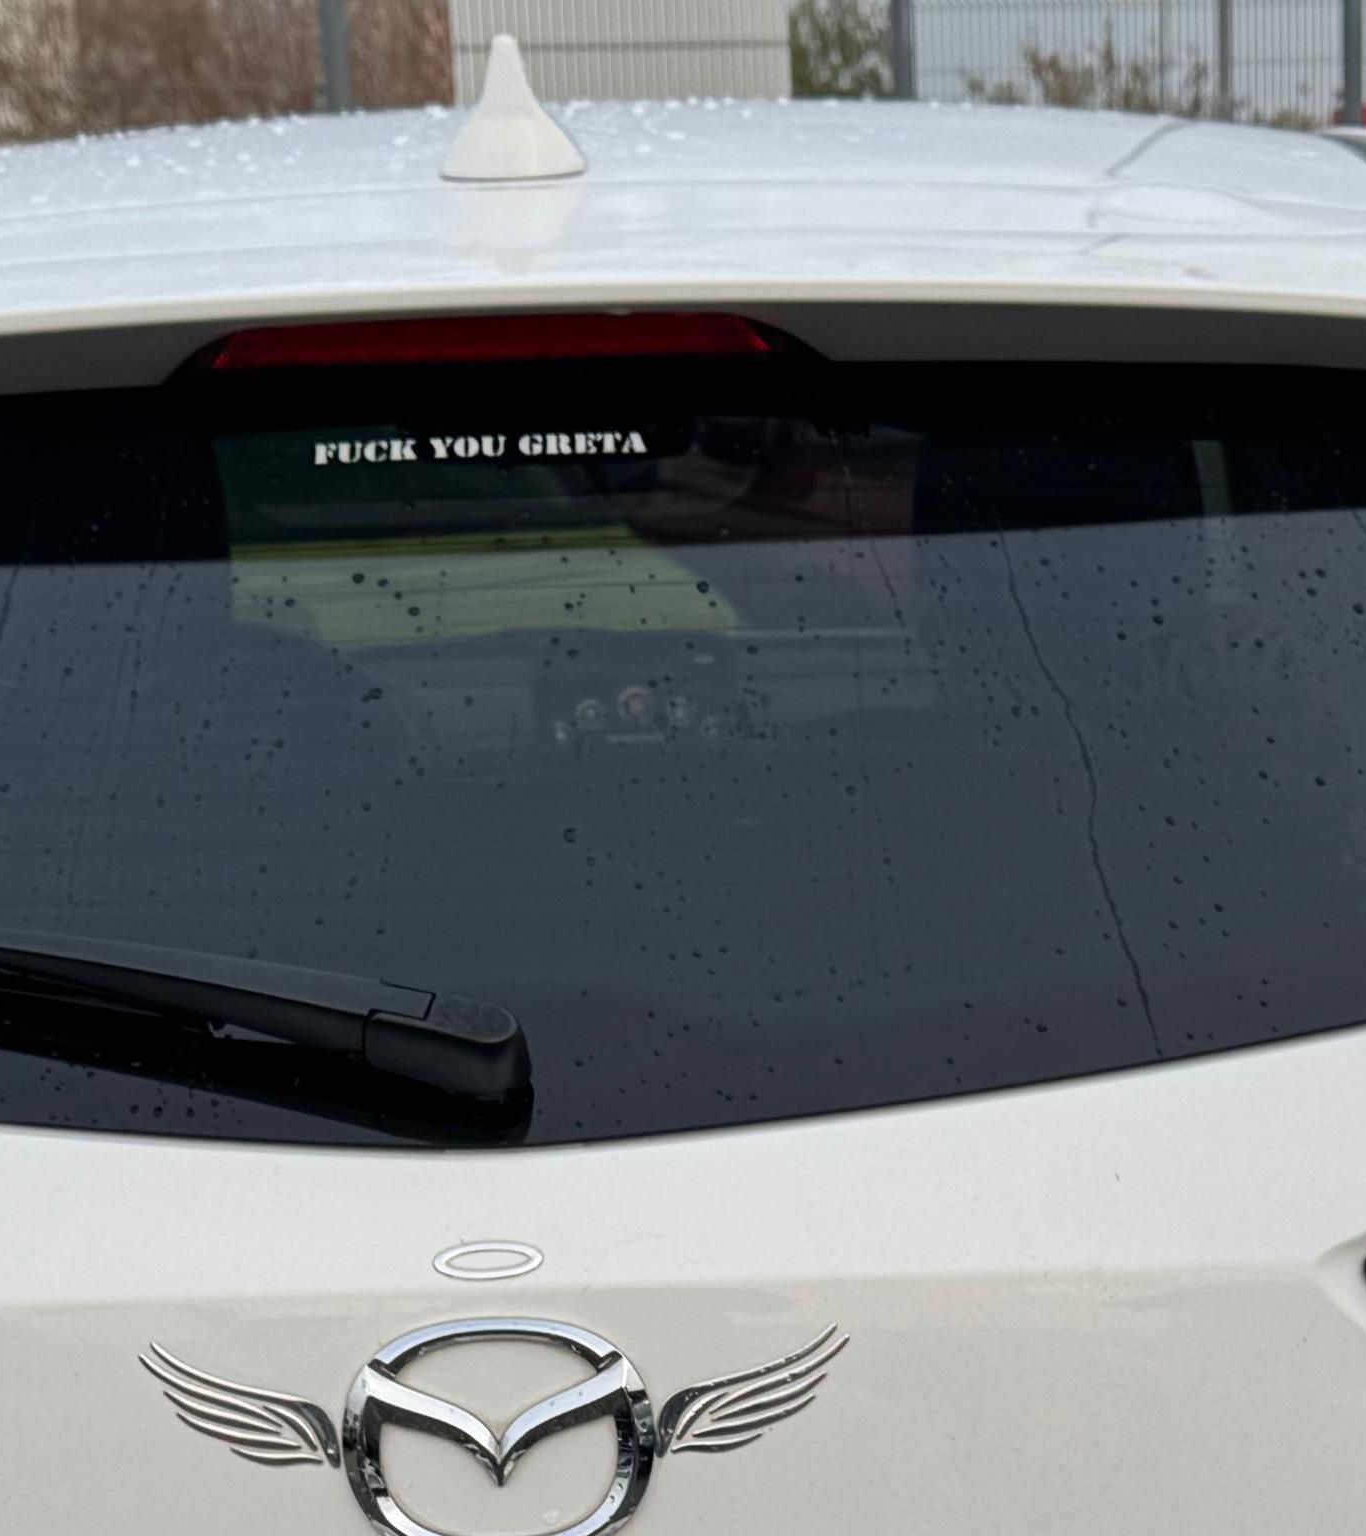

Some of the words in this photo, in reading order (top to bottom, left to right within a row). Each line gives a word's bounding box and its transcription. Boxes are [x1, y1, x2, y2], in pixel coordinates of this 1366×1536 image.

[314, 439, 417, 465] FUCK
[430, 435, 507, 459] YOU
[518, 431, 648, 456] GRETA
